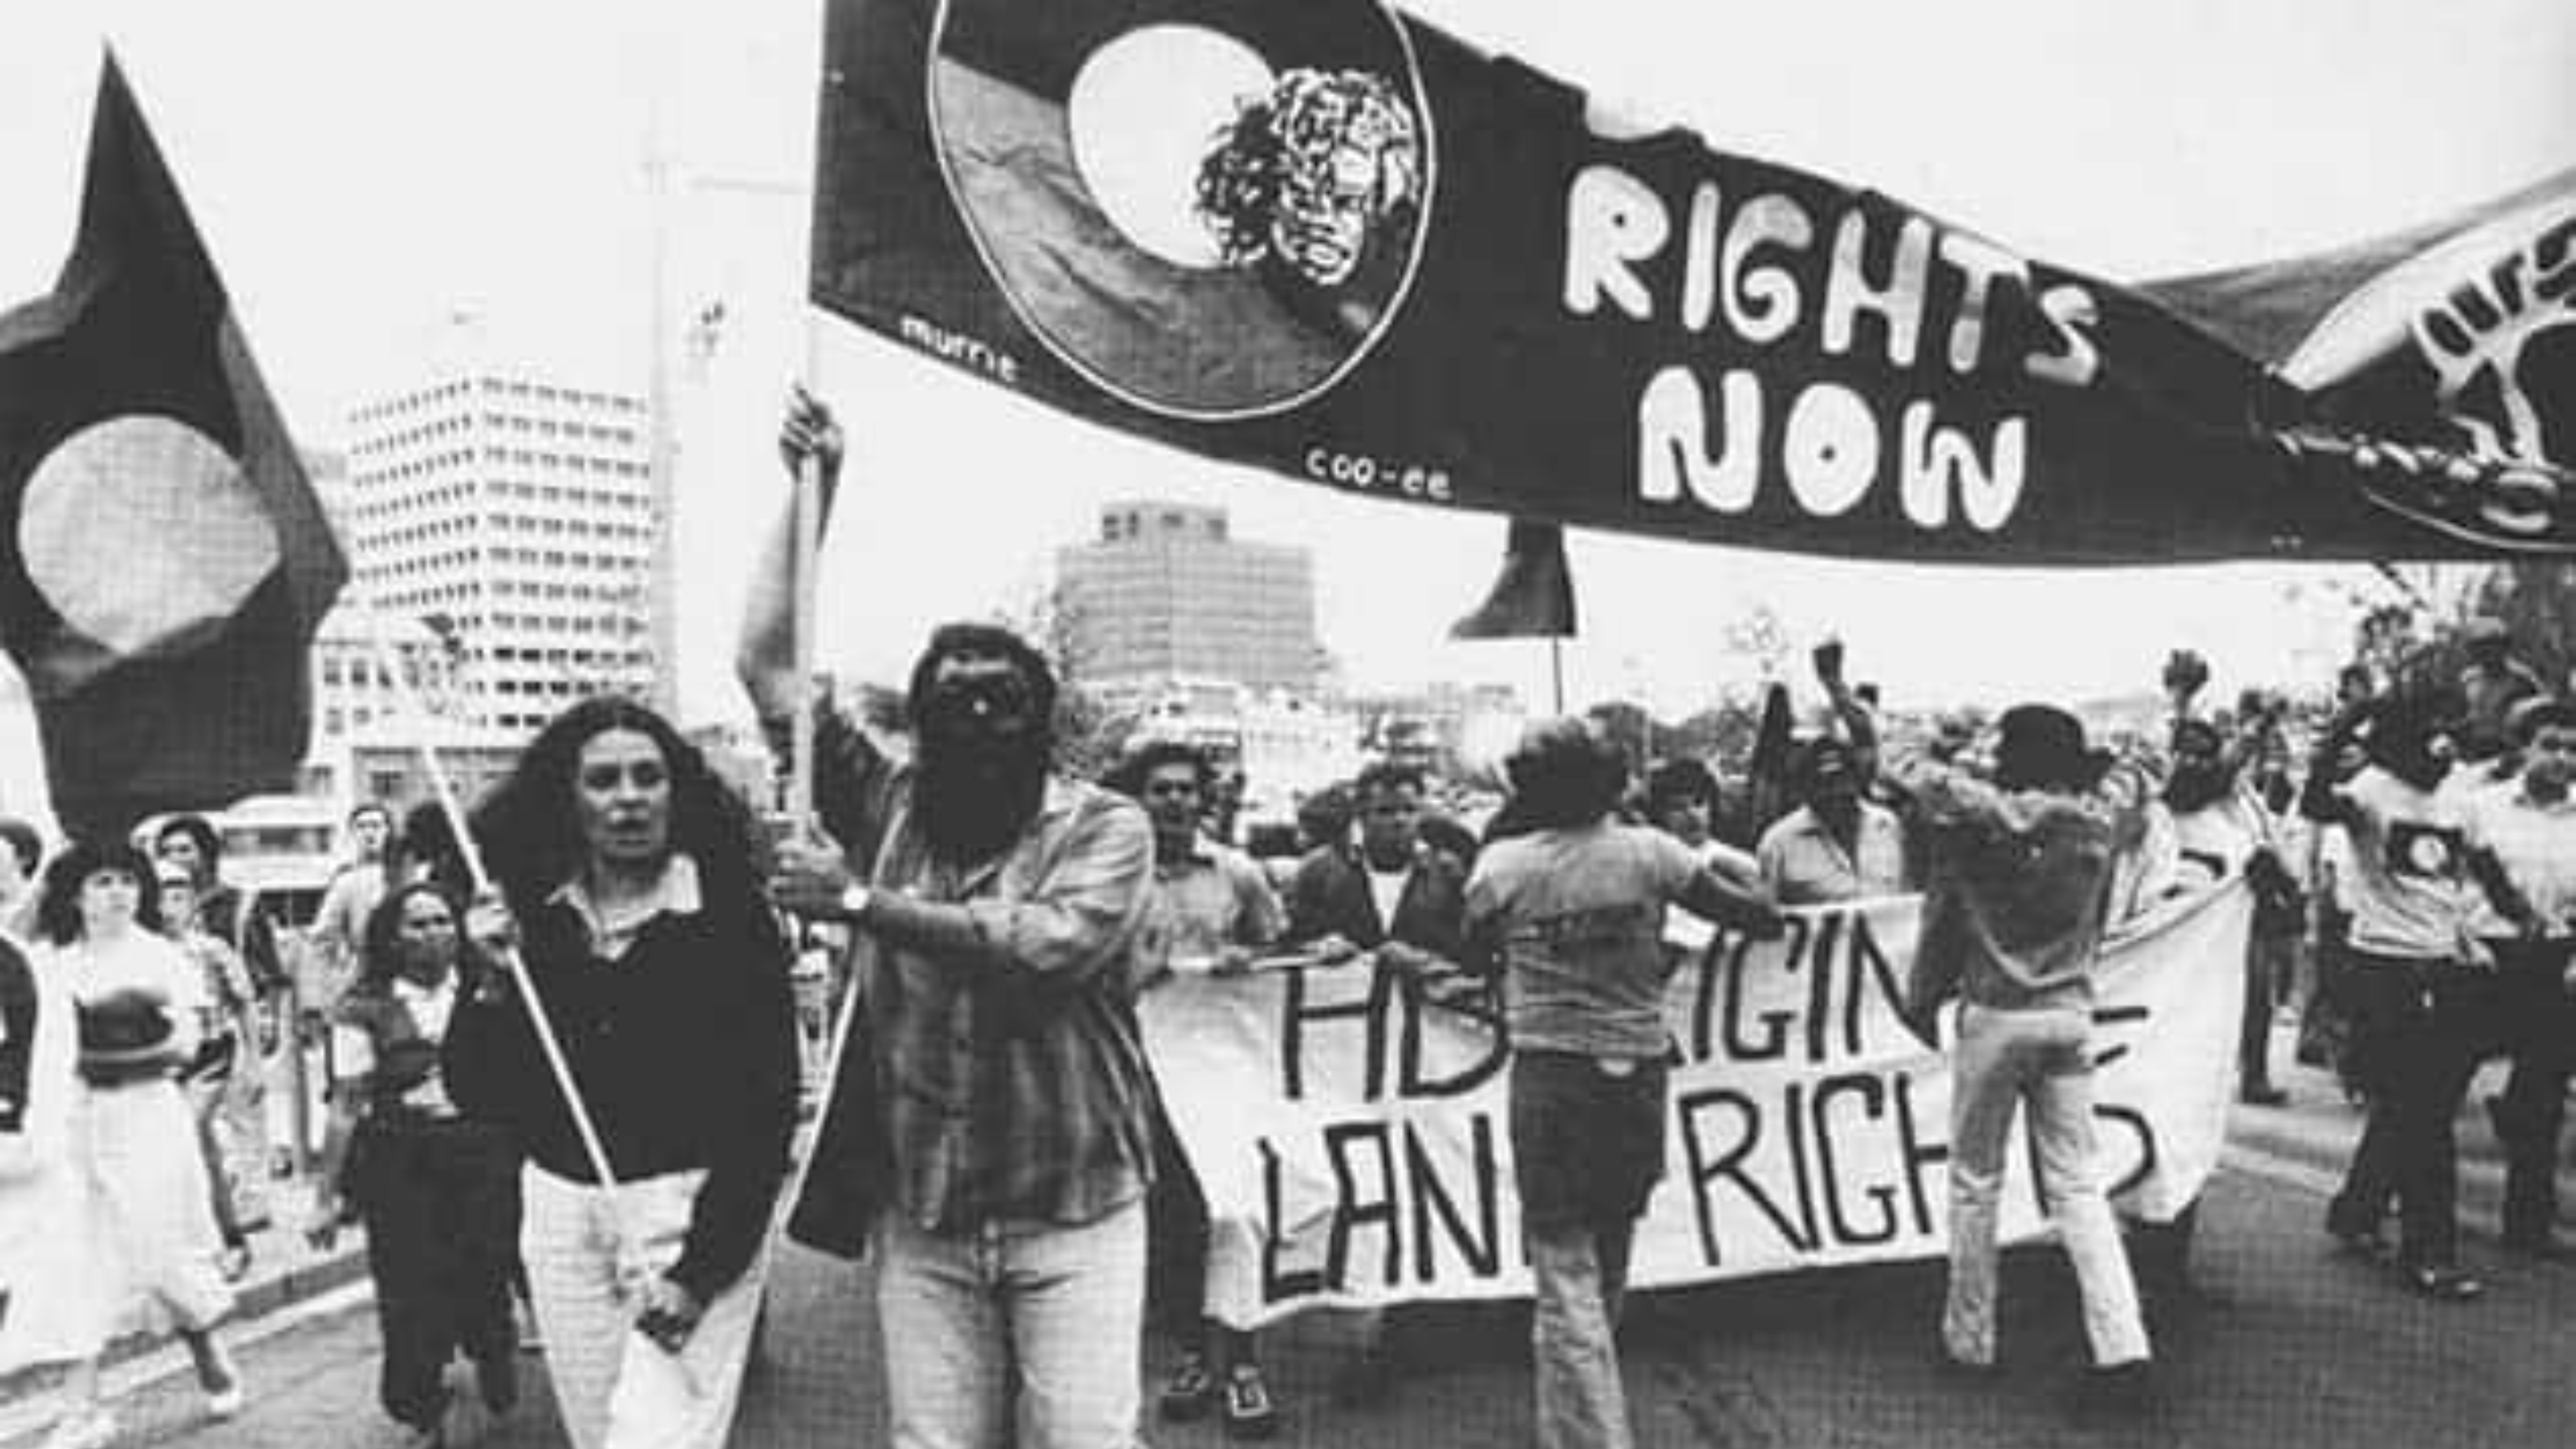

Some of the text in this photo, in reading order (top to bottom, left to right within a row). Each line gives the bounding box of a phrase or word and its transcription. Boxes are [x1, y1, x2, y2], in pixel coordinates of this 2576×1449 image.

[1564, 164, 2098, 386] RIGHTS
[1638, 366, 2026, 531] NOW
[1256, 1112, 1502, 1301] LAN
